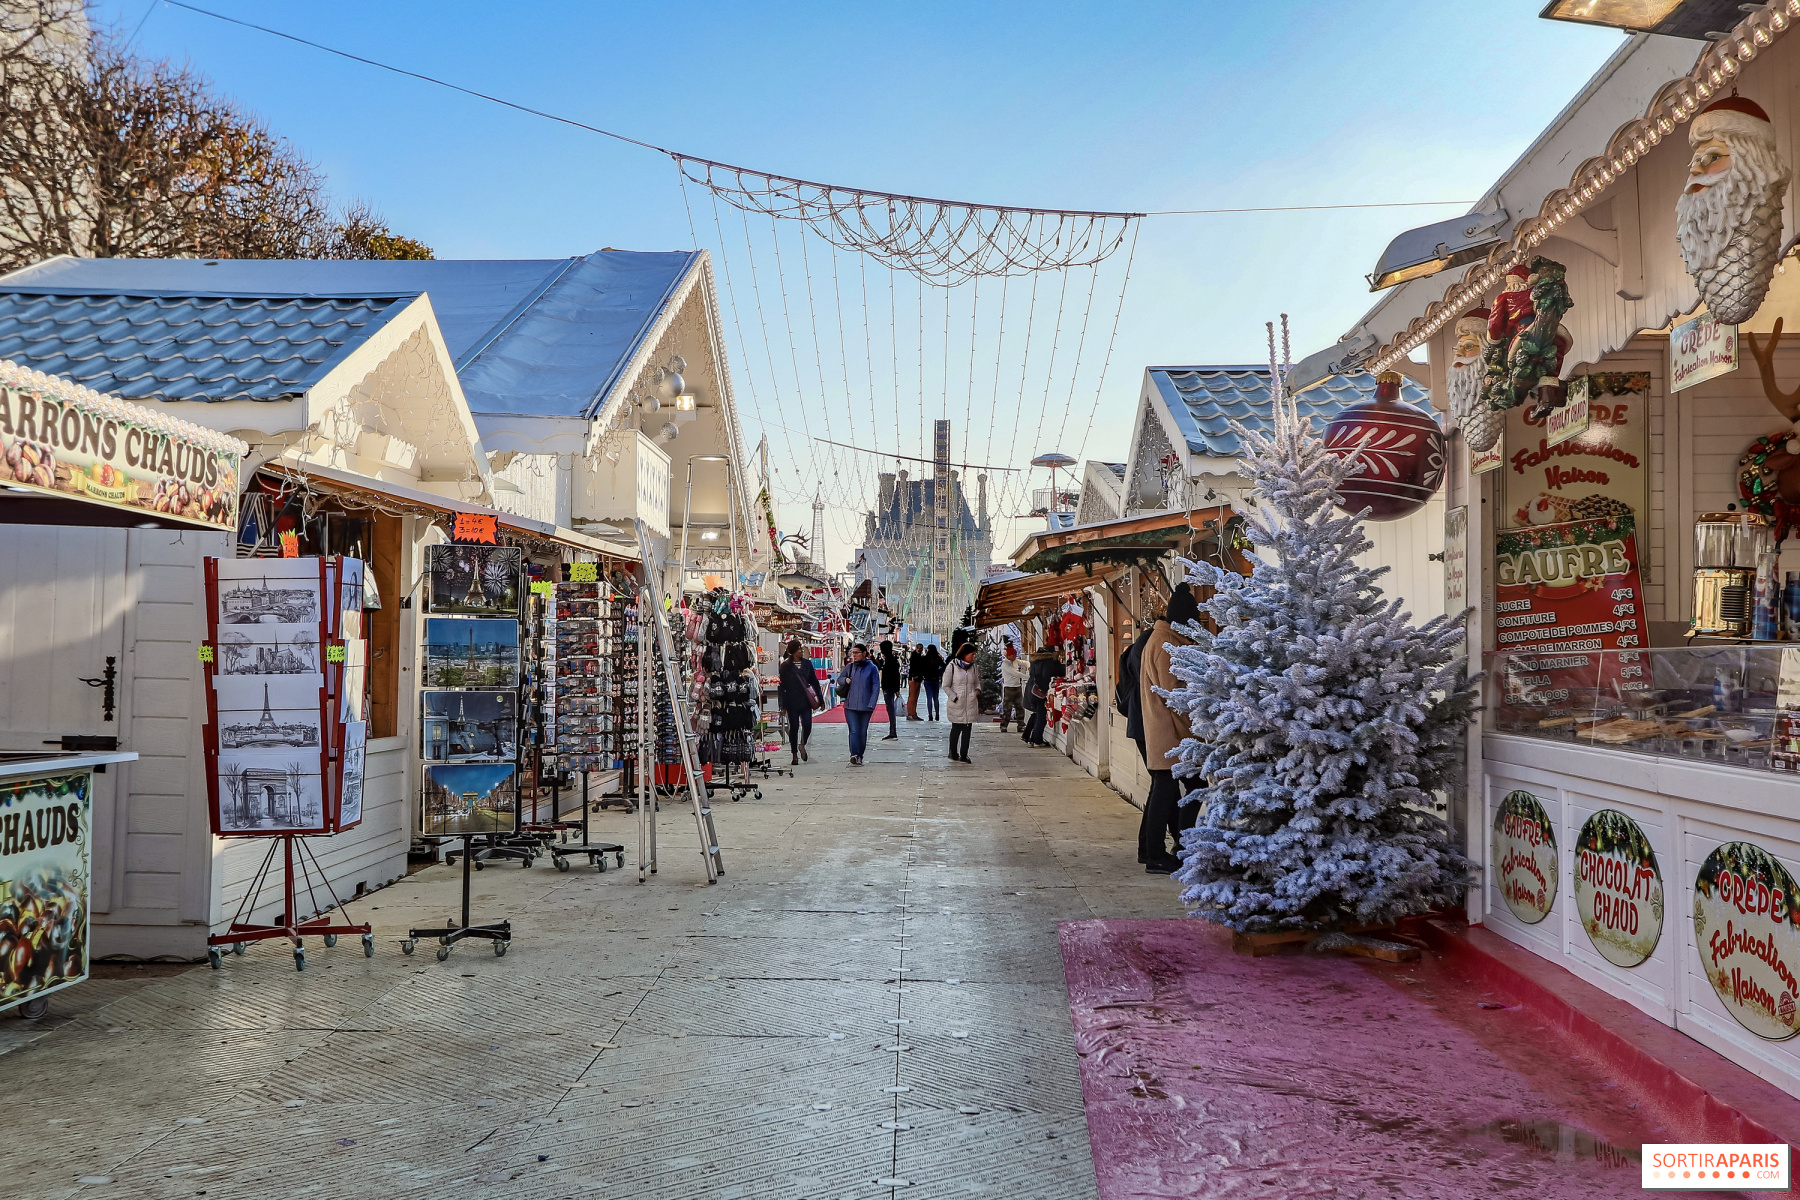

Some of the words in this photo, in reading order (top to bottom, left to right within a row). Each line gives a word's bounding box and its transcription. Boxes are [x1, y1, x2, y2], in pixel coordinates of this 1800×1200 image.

[1674, 355, 1708, 384] Fabrication
[1710, 350, 1733, 365] Maison
[1549, 408, 1571, 434] CHOCOLAT
[125, 428, 219, 488] CHAUDS
[1510, 439, 1640, 475] Fabrication
[108, 491, 125, 499] CHAUDS
[1544, 465, 1610, 490] Maison
[1495, 542, 1630, 586] GAUFRE
[1496, 599, 1531, 612] SUCRE
[1497, 612, 1556, 627] CONFITURE
[1499, 628, 1550, 642] COMPOTE
[1551, 627, 1567, 638] DE
[1568, 622, 1614, 636] POMMES
[1554, 639, 1602, 652] MARRON
[1502, 661, 1540, 673] GRAND
[1540, 656, 1589, 670] MARNIER
[0, 803, 79, 856] HAUDS
[1504, 812, 1541, 848] GAUFRE
[1501, 846, 1548, 893] Fabrication
[1581, 851, 1654, 901] CHOCOLAT
[1512, 878, 1535, 908] Maison
[1594, 890, 1639, 935] CHAUD
[1709, 919, 1799, 1000] Fabrication
[1731, 967, 1776, 1017] Maison
